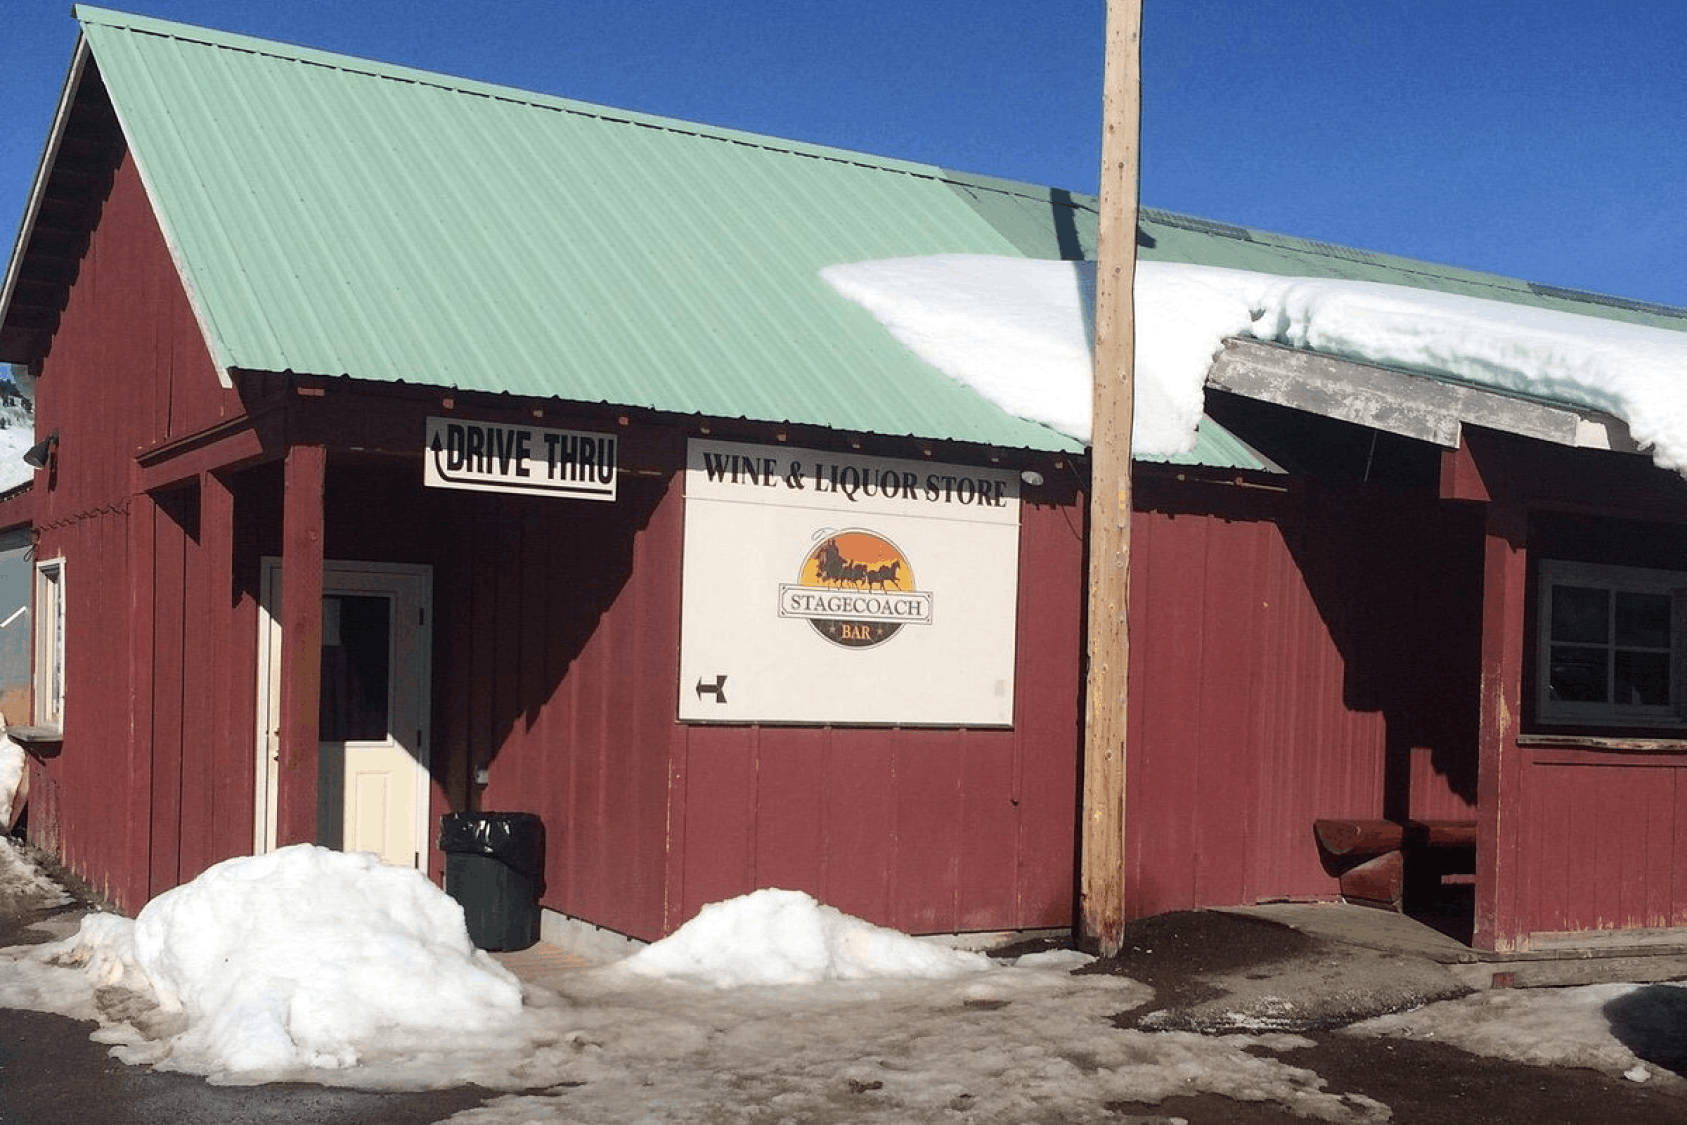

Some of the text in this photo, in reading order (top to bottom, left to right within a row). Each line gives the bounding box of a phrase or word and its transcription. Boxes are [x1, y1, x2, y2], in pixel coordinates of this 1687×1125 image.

[446, 423, 614, 484] DRIVE THRU
[703, 452, 1007, 508] WINE & LIQUOR STORE
[790, 594, 922, 616] STAGECOACH
[841, 624, 872, 640] BAR
